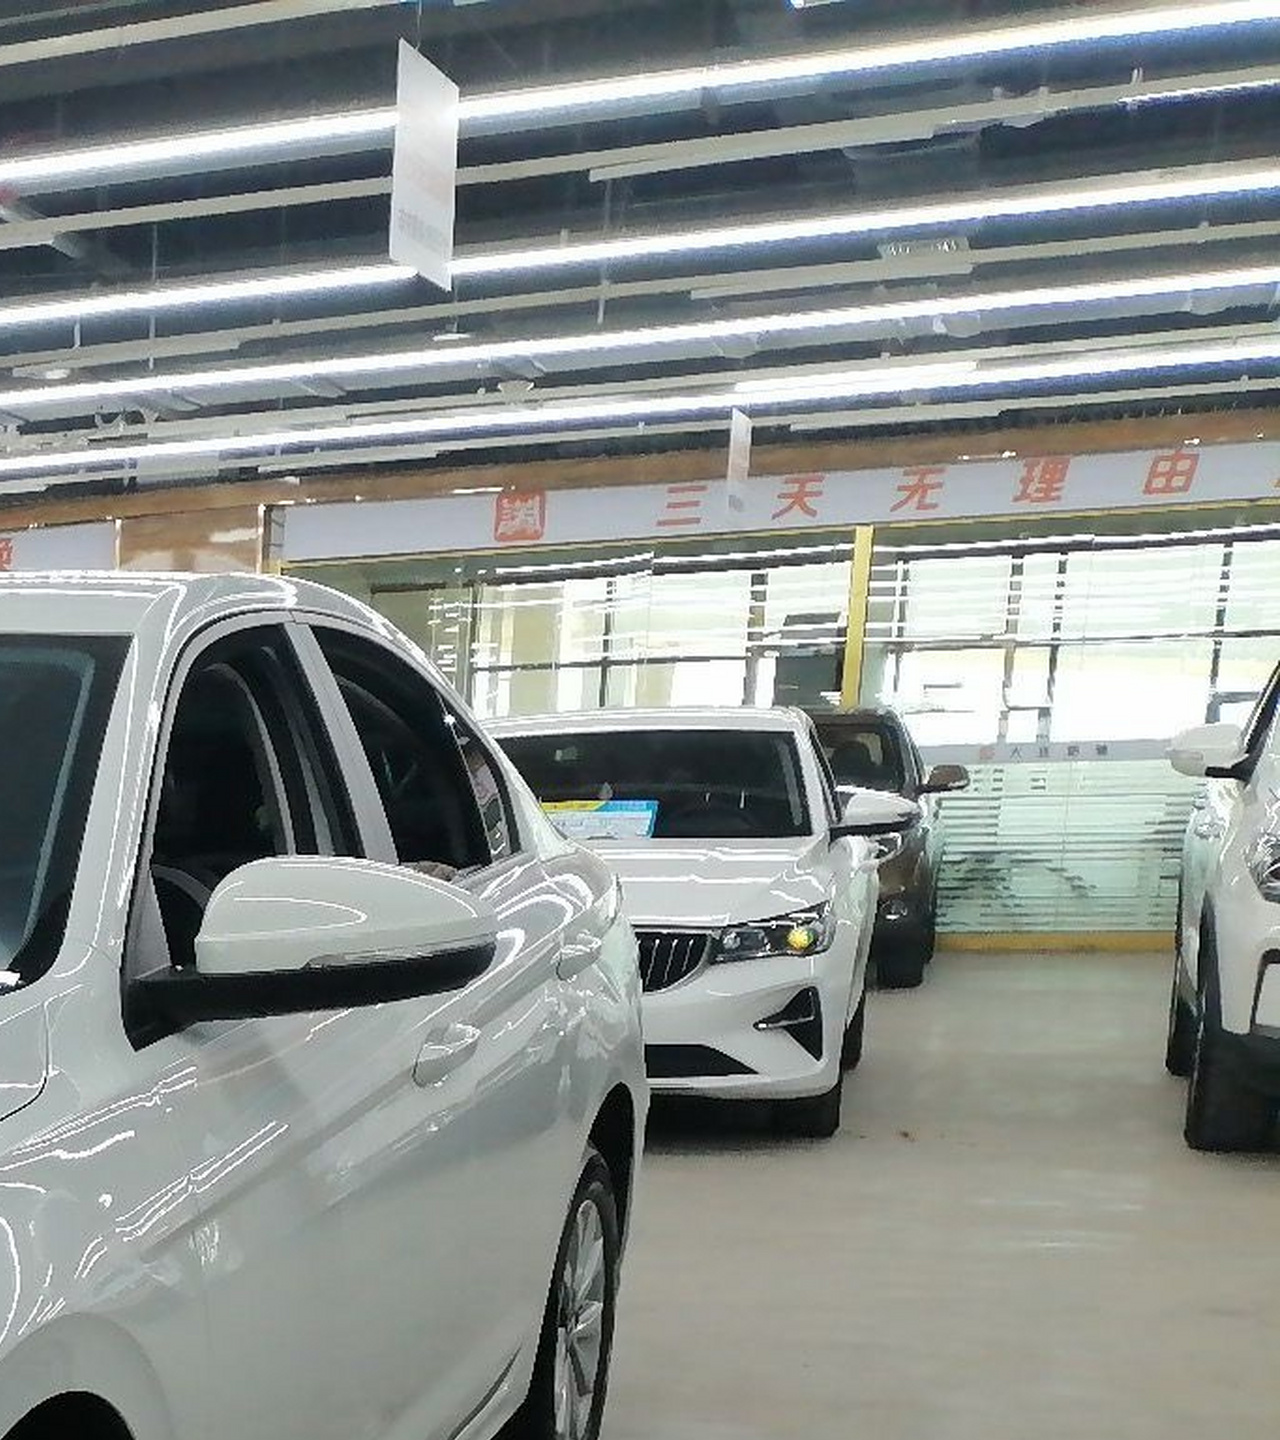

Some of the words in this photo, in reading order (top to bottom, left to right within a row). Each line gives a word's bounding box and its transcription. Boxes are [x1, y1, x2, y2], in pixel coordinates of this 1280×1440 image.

[656, 448, 1280, 527] 三天无理由
